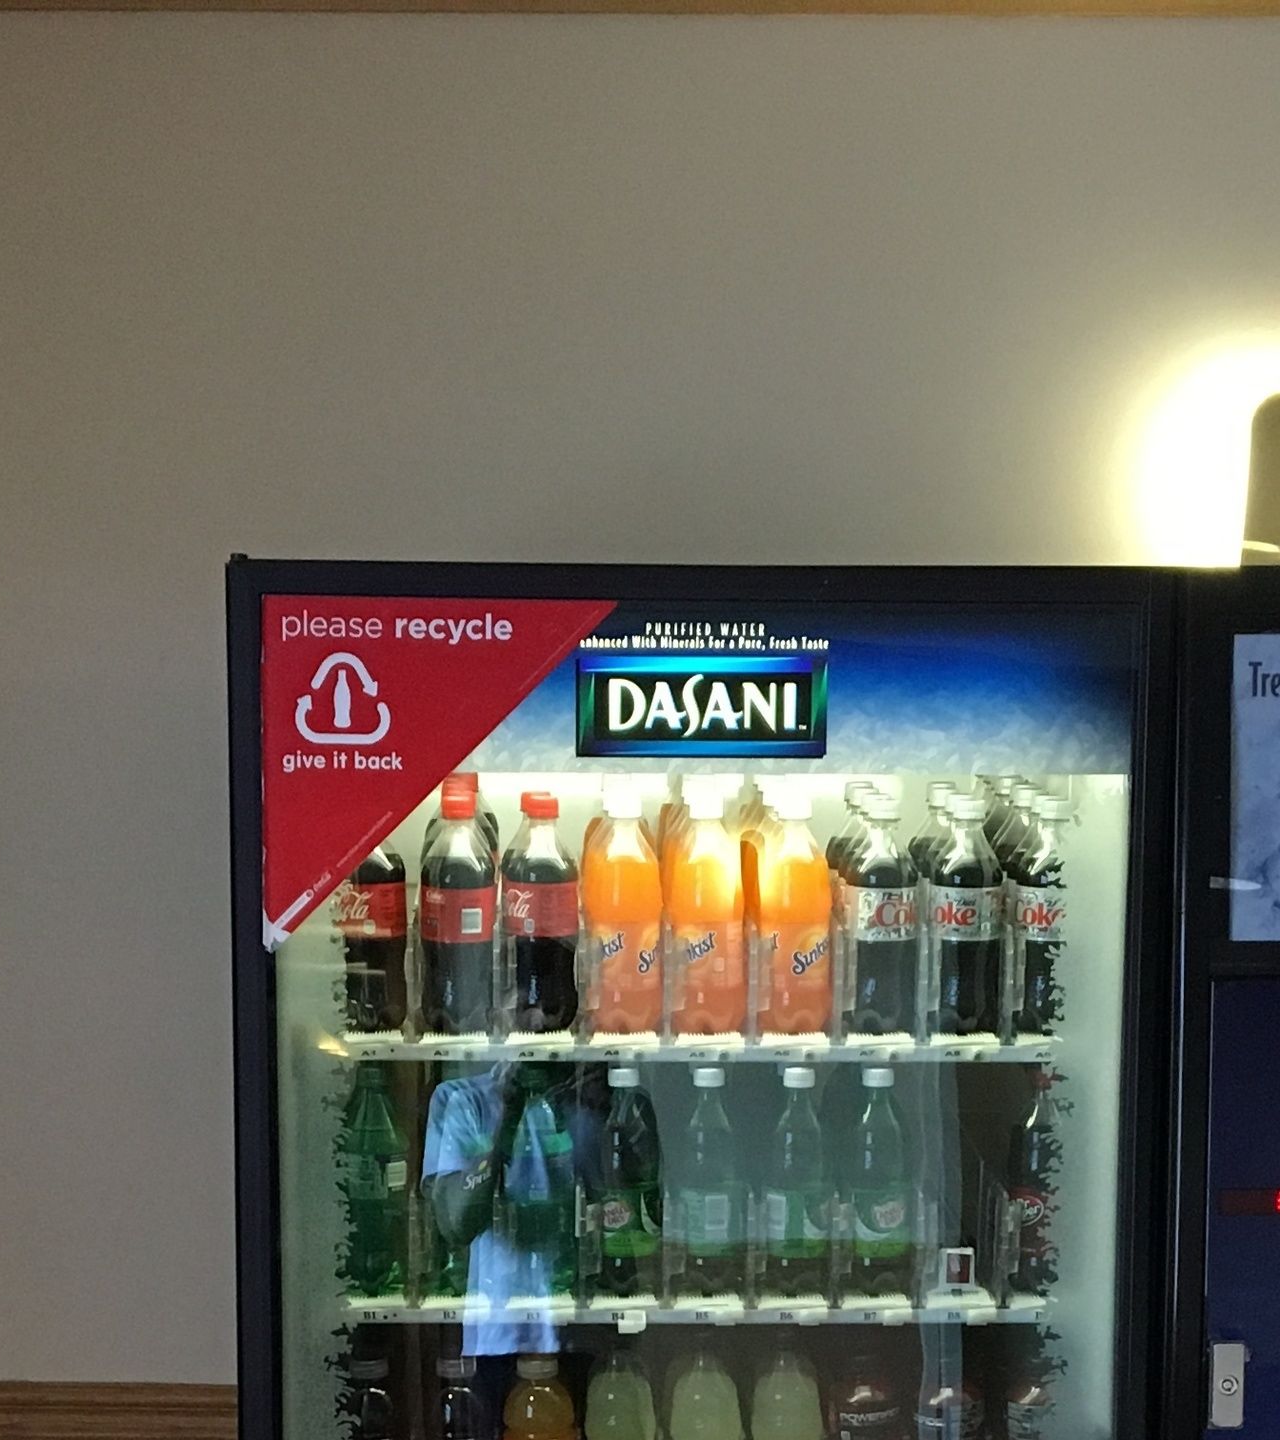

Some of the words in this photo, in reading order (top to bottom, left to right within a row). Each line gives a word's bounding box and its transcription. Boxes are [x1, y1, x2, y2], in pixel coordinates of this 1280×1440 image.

[281, 609, 383, 641] please
[395, 613, 513, 645] recycle
[645, 622, 712, 636] PURIFIED
[720, 622, 766, 636] WATER
[631, 635, 657, 649] With
[660, 635, 705, 649] Minerals
[708, 635, 727, 649] For
[729, 638, 735, 649] a
[738, 636, 766, 651] Pure,
[769, 636, 798, 650] Fresh
[801, 636, 830, 650] Taste
[607, 673, 797, 738] DASANI
[282, 751, 326, 772] give
[333, 751, 348, 769] it
[354, 751, 403, 771] back
